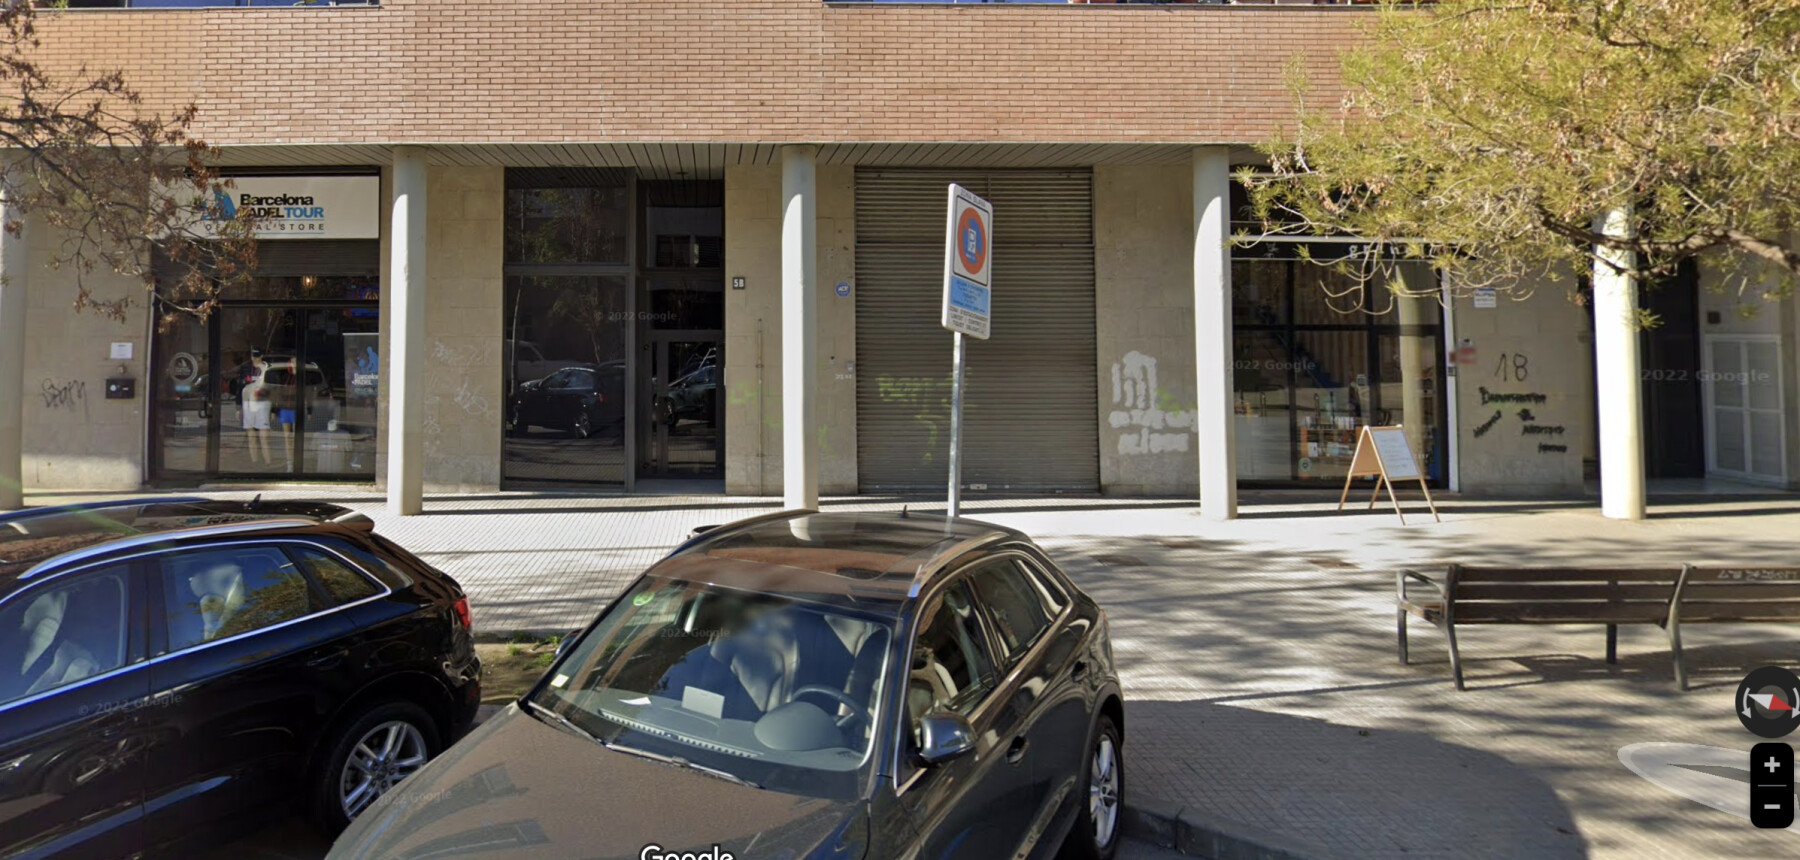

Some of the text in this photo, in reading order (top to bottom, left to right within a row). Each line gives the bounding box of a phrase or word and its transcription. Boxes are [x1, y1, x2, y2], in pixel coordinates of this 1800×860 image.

[240, 193, 314, 206] Barcelona
[280, 223, 325, 231] STORE
[733, 278, 745, 288] 5B
[1494, 353, 1528, 382] 18
